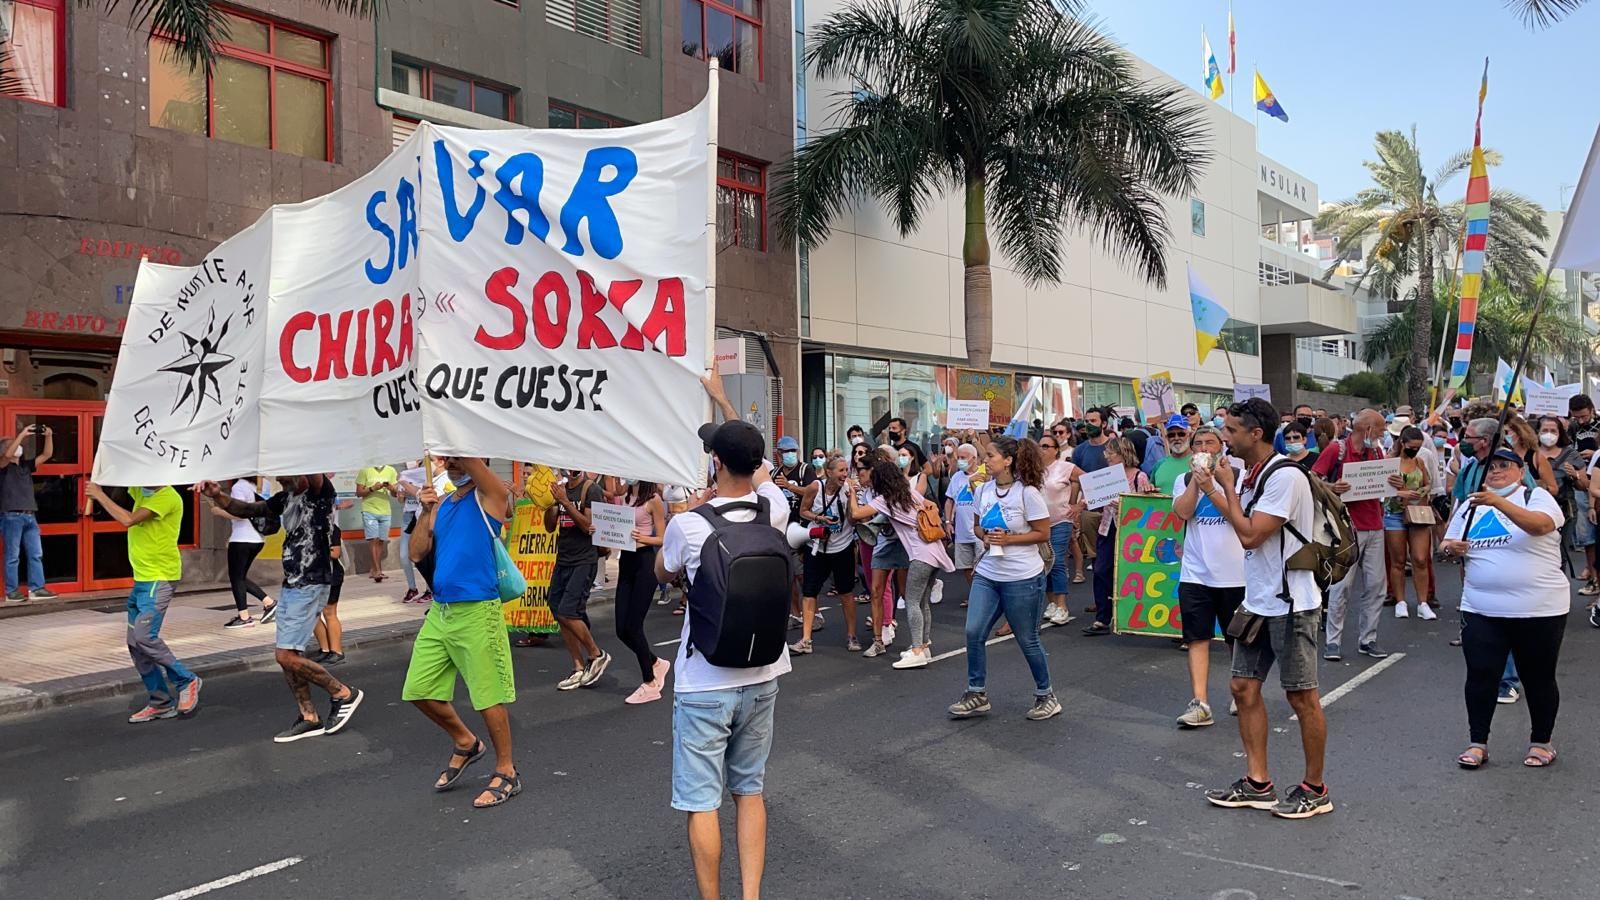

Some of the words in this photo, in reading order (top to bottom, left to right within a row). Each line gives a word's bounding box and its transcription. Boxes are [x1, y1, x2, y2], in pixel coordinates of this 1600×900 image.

[23, 311, 105, 333] BRAVO
[148, 311, 175, 343] DE
[279, 293, 414, 383] CHIRA
[425, 363, 488, 401] QUE
[494, 364, 608, 411] CUESTE
[201, 443, 212, 462] A
[220, 361, 248, 440] OESTE
[1121, 507, 1184, 532] PIEN
